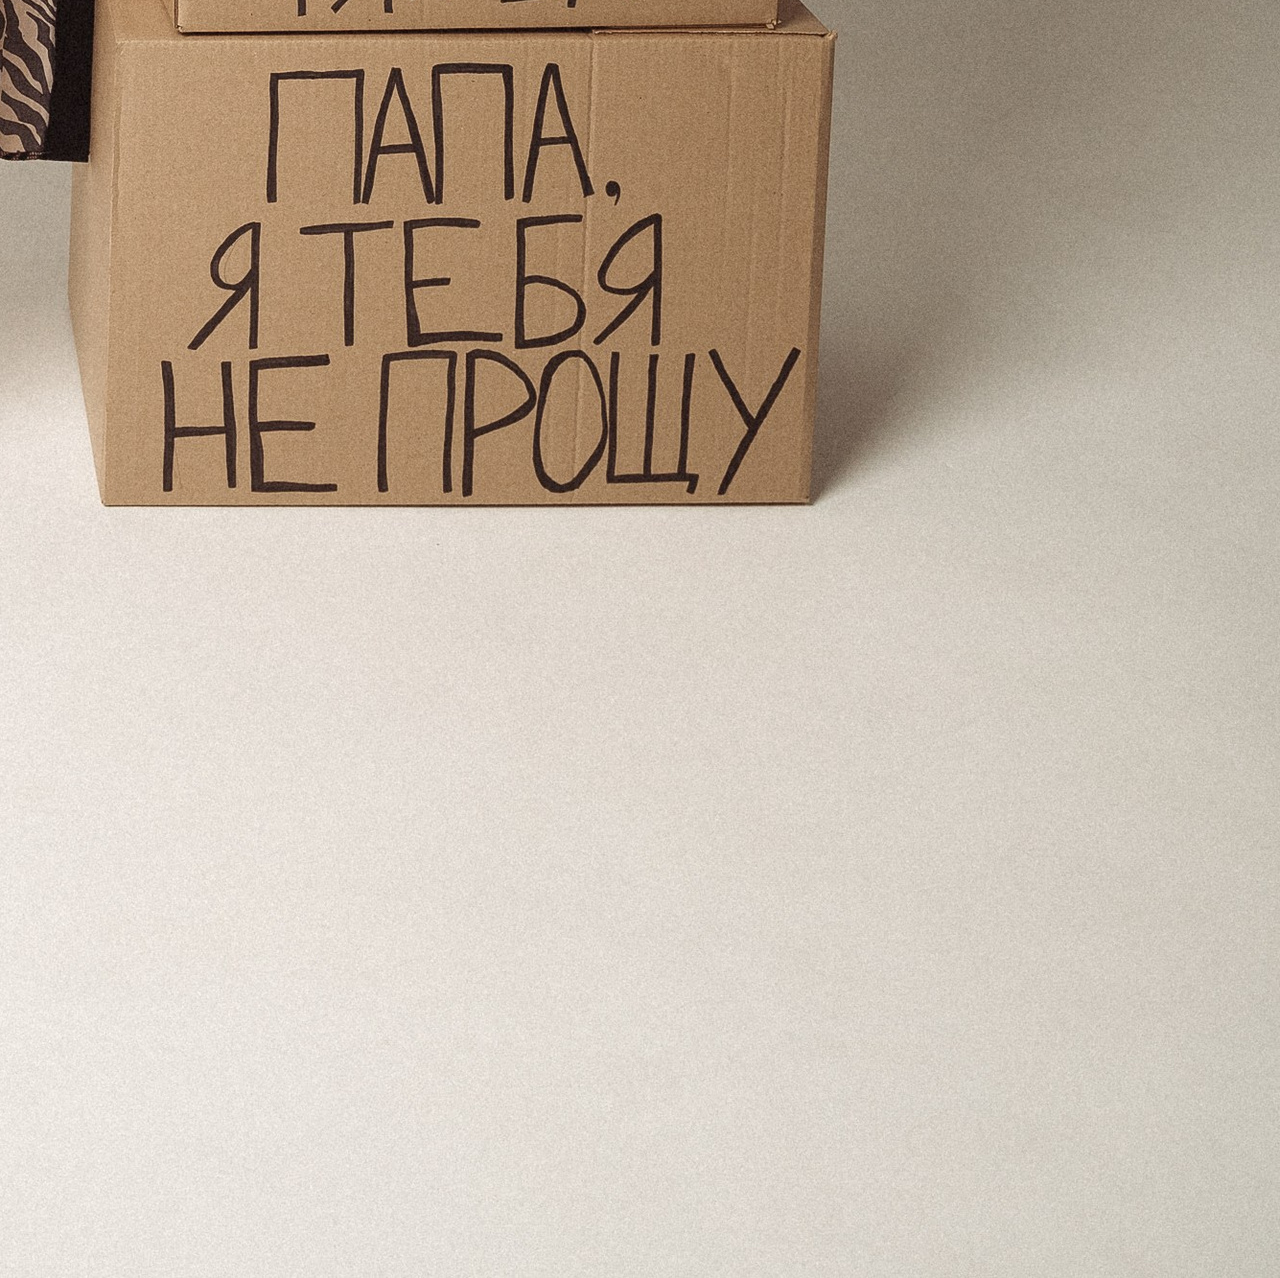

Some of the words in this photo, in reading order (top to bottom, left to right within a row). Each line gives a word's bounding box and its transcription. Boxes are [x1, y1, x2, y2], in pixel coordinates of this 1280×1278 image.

[267, 62, 622, 206] ПАПА,
[188, 221, 261, 350] Я
[299, 213, 663, 350] ТЕБЯ
[161, 353, 338, 493] НЕ
[377, 347, 801, 497] ПРОЩУ
